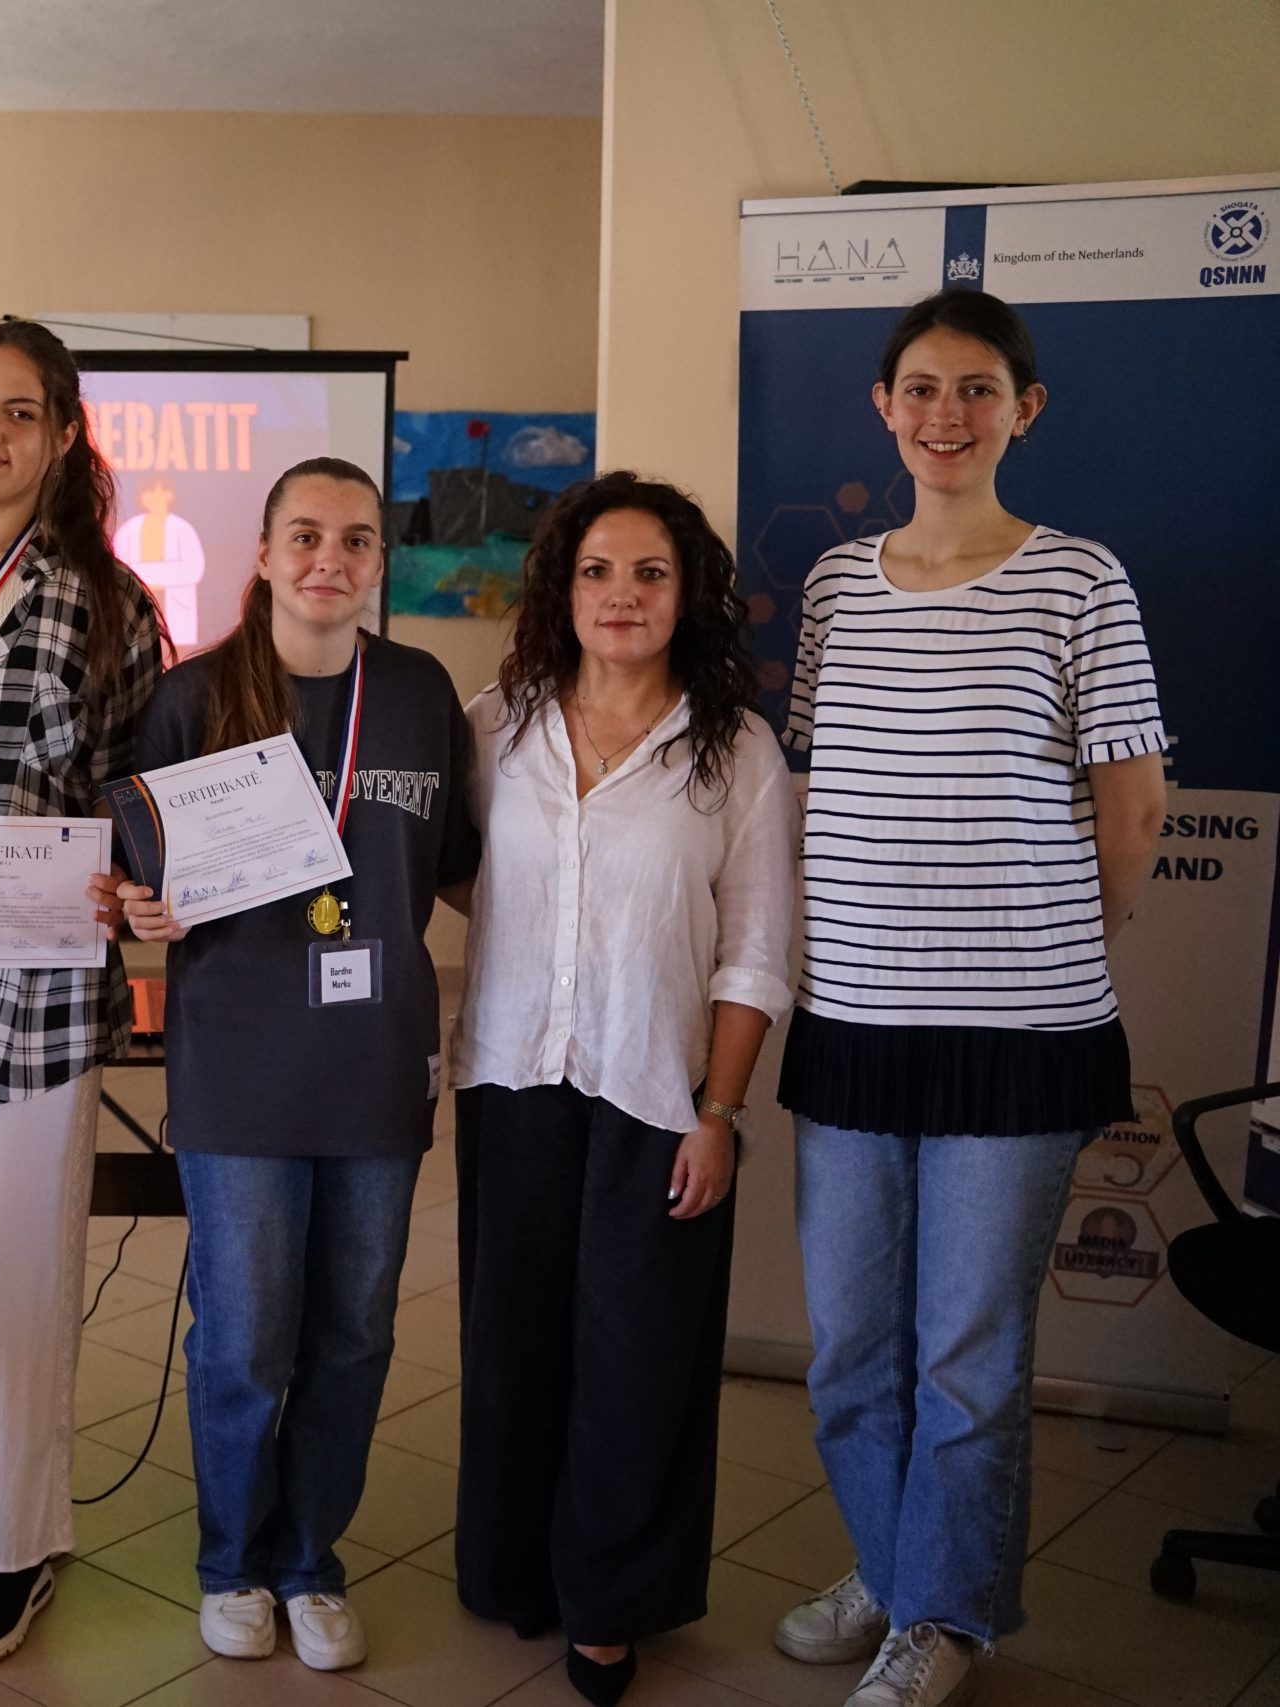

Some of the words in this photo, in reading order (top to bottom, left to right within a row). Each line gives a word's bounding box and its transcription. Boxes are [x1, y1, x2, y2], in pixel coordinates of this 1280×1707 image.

[1220, 201, 1258, 212] SHOQATA
[993, 252, 1041, 265] Kingdom
[1044, 250, 1057, 261] of
[1058, 250, 1075, 261] the
[1078, 247, 1144, 260] Netherlands
[1200, 264, 1266, 287] QSNNN
[169, 770, 262, 809] CERTIFIKATË
[1152, 856, 1223, 881] AND
[330, 966, 353, 976] Bardhe
[332, 980, 352, 989] Marku
[1078, 1235, 1126, 1250] MEDIA
